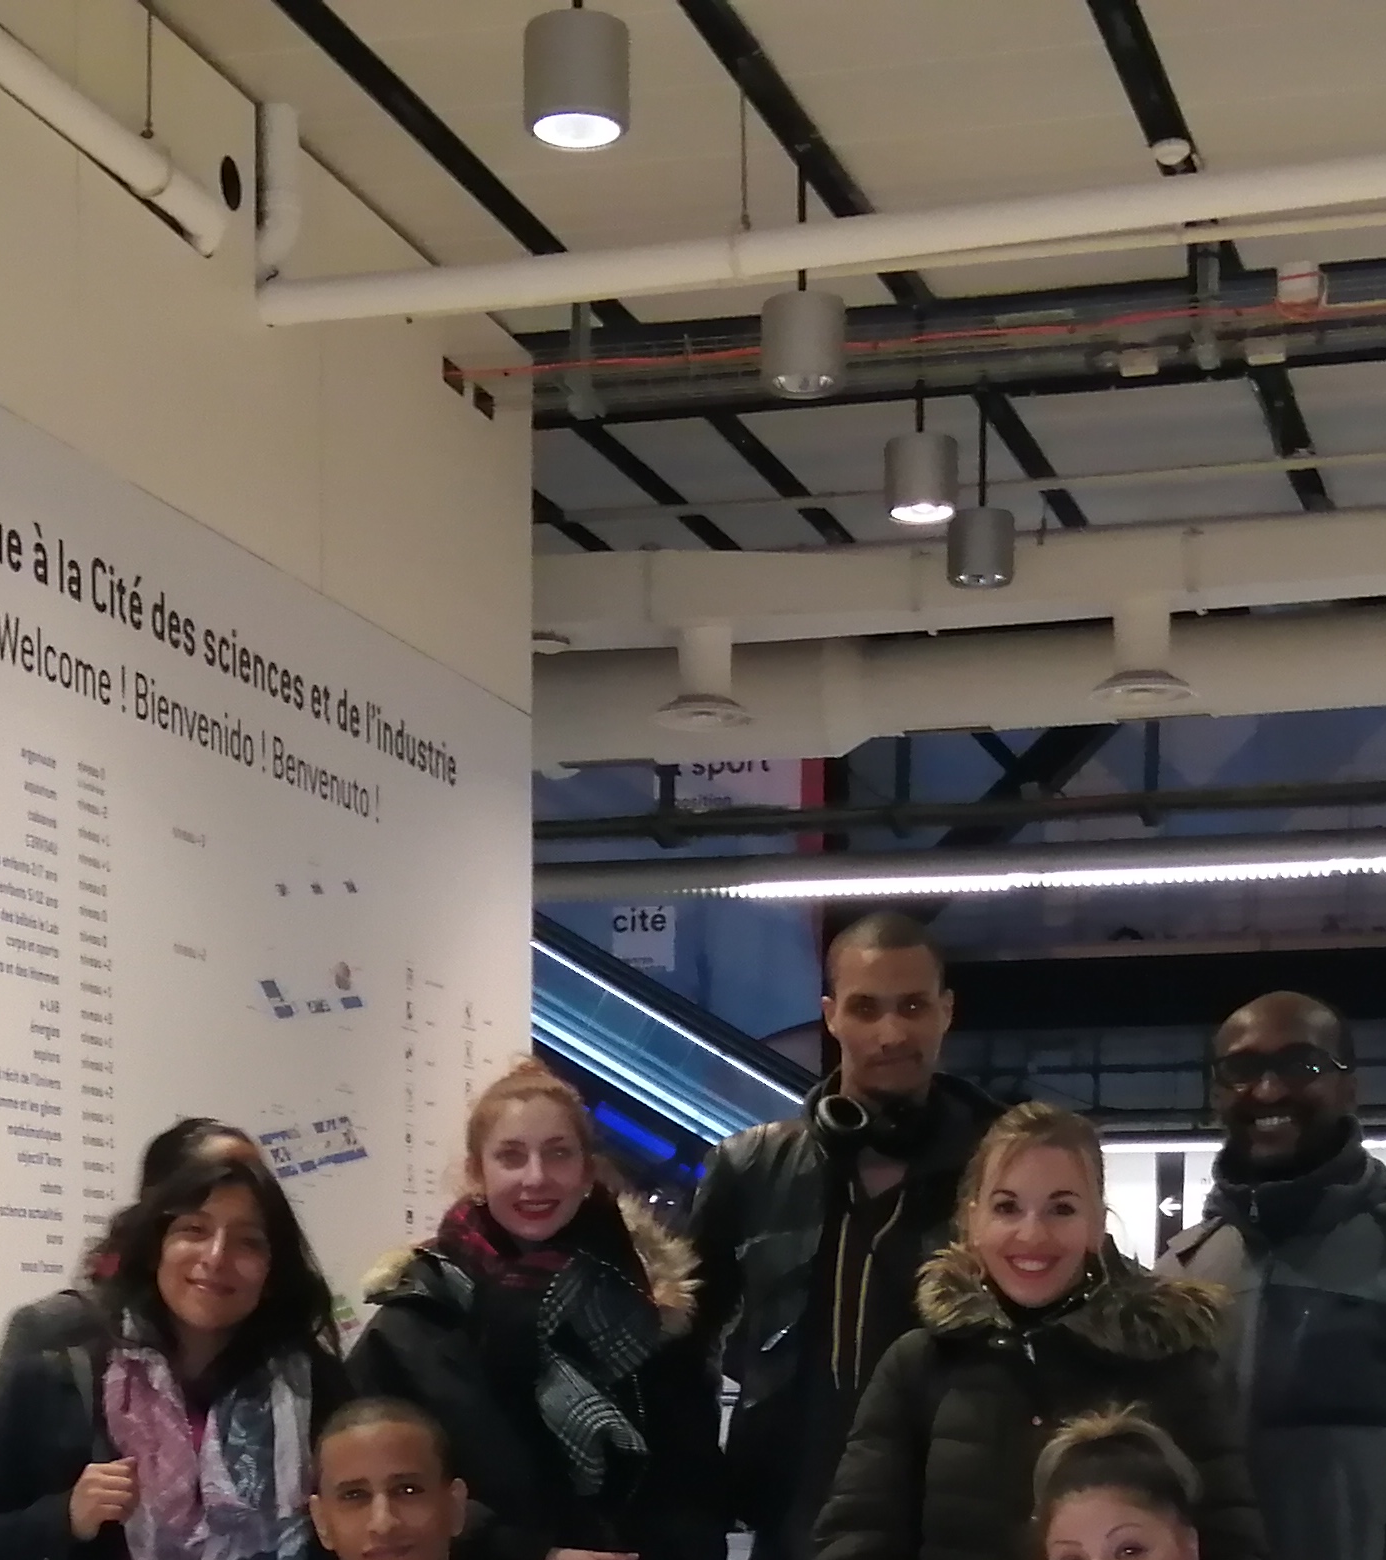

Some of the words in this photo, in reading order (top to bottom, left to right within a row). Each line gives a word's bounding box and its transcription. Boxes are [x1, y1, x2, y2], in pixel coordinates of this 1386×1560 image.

[33, 521, 49, 586] à
[59, 538, 82, 603] la
[90, 556, 143, 631] Cité
[151, 591, 196, 657] des
[203, 628, 304, 712] sciences
[310, 683, 332, 725] et
[336, 688, 361, 739] de
[365, 700, 458, 787] l'industrie
[134, 672, 255, 768] Bienvenido
[272, 735, 370, 819] Benvenuto
[613, 905, 667, 933] cité
